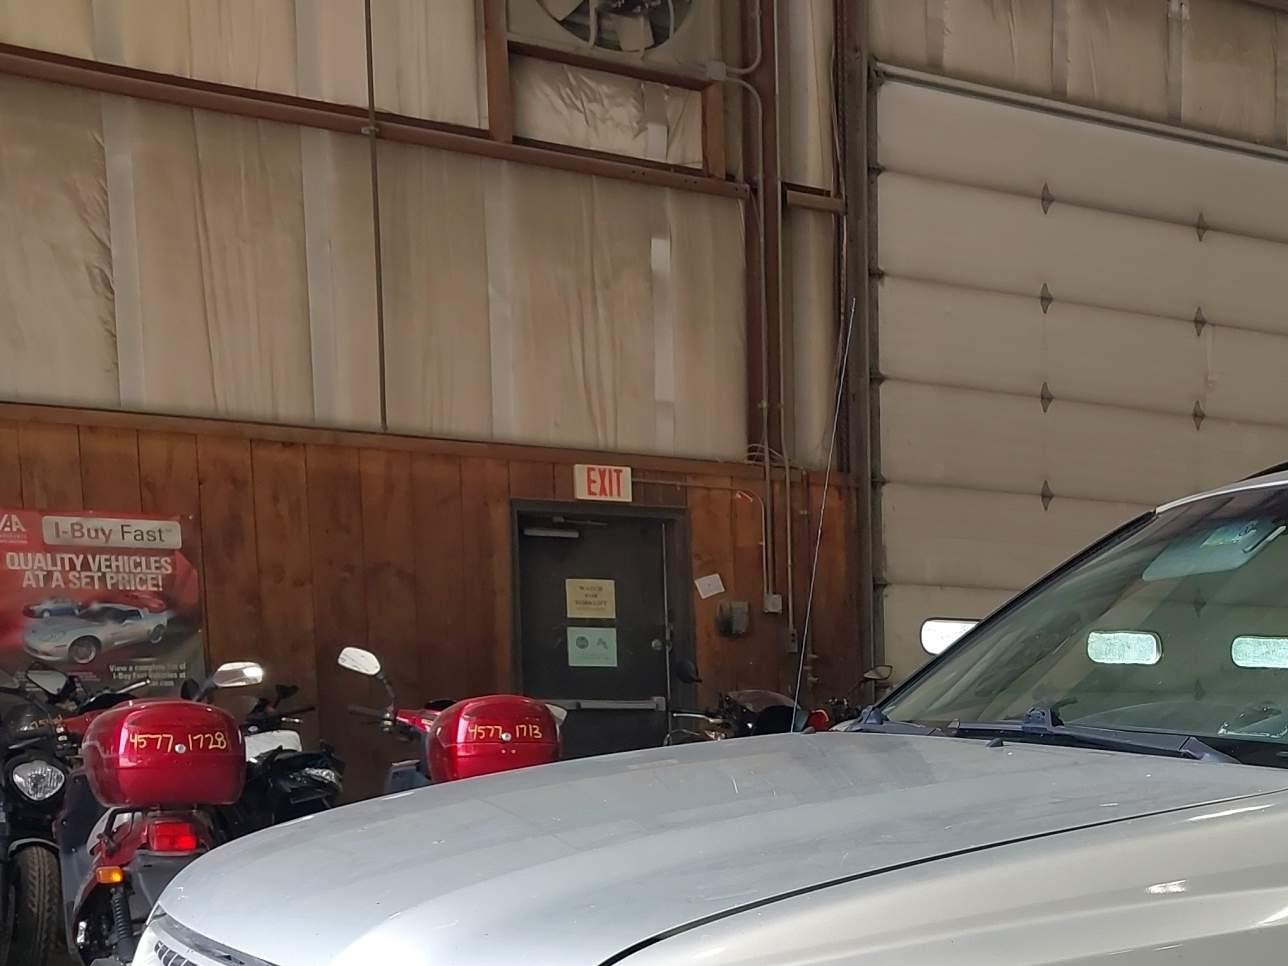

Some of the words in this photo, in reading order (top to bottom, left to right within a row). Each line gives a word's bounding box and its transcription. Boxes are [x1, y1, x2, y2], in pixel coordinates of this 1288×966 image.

[586, 467, 623, 497] EXIT
[54, 522, 113, 543] I-Buy
[120, 524, 165, 543] Fast
[6, 552, 86, 572] QUALITY
[86, 554, 172, 574] VEHICLES
[23, 571, 47, 588] AT
[51, 572, 65, 588] A
[69, 572, 101, 590] SET
[105, 573, 163, 591] PRICE!
[129, 733, 173, 752] 4577
[188, 732, 227, 751] 1728
[469, 724, 503, 740] 4577
[515, 724, 543, 739] 1713
